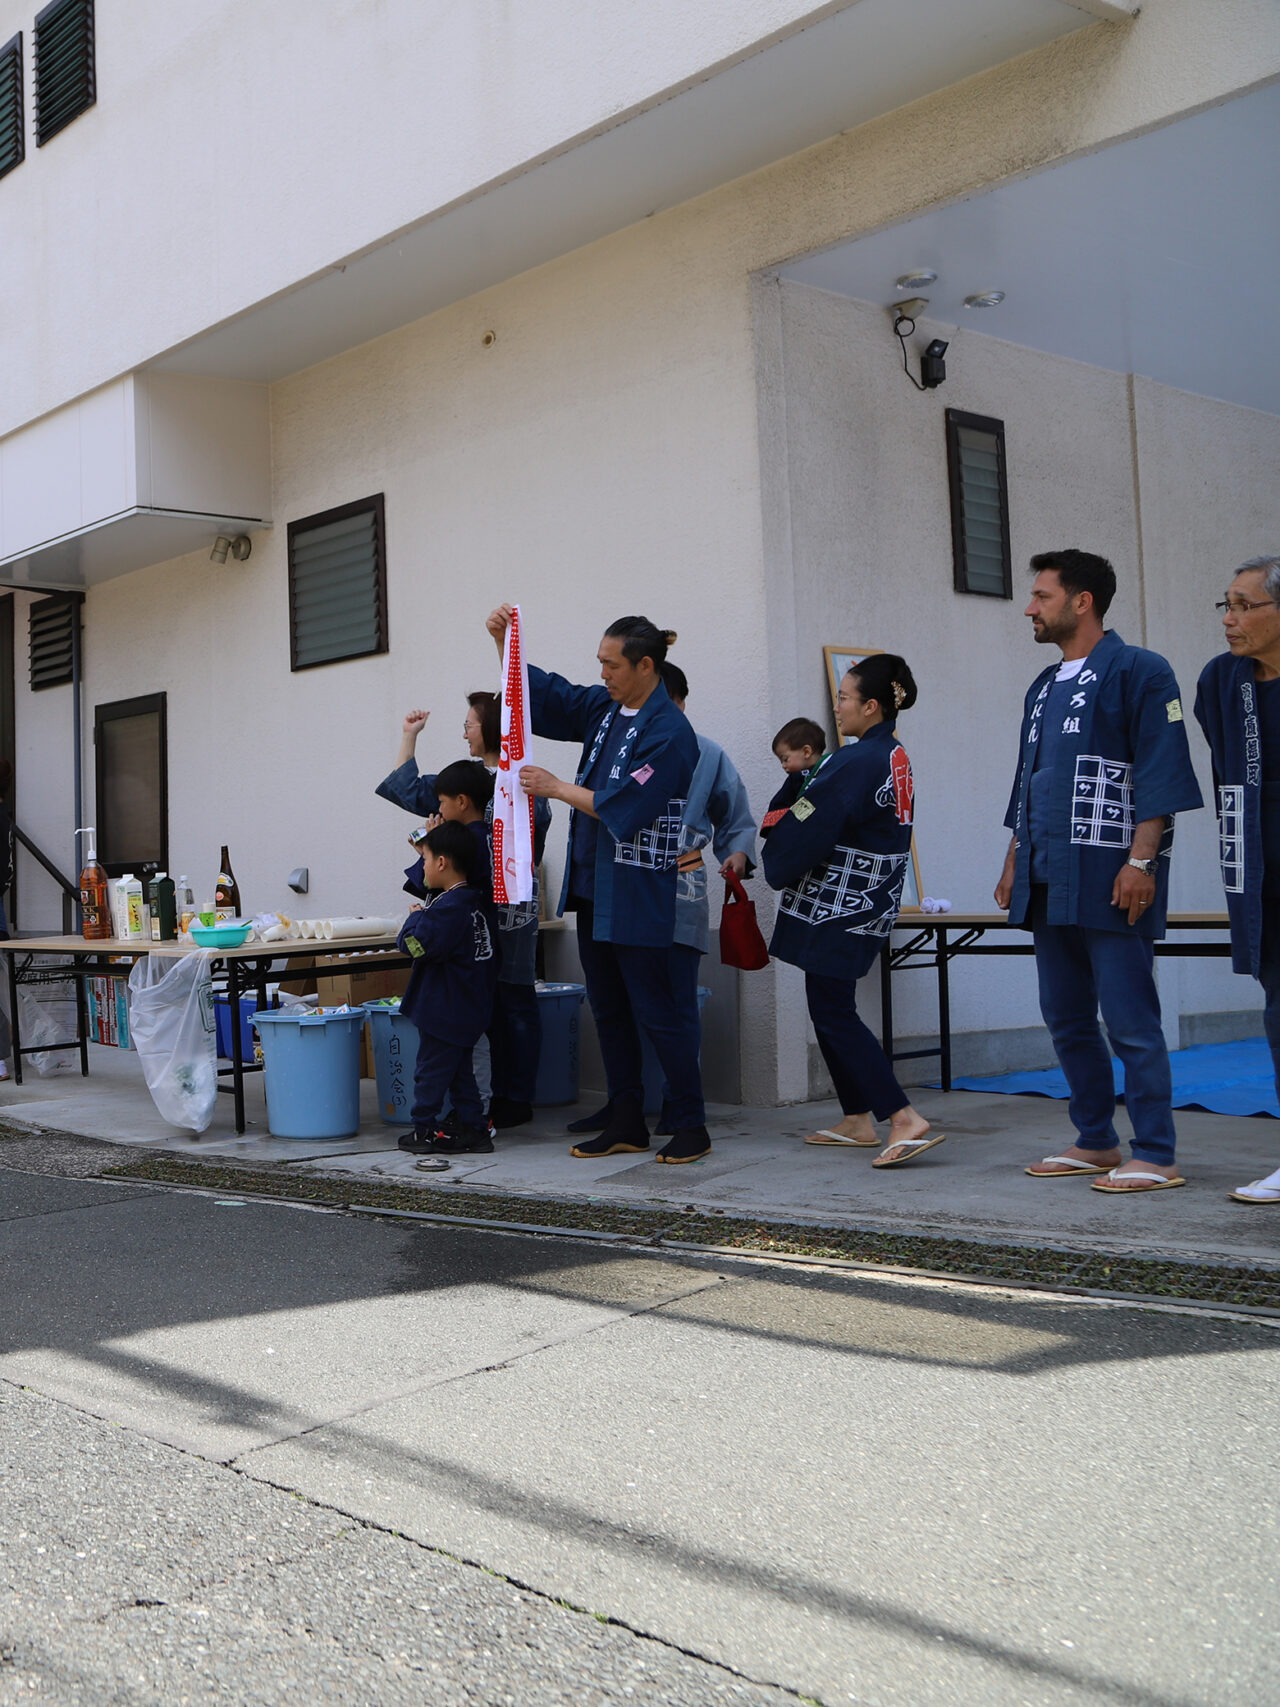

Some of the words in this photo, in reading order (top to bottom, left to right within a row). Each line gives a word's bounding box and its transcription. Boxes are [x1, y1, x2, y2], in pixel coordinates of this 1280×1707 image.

[1061, 669, 1097, 734] ひろ組
[609, 727, 638, 780] ひろ組
